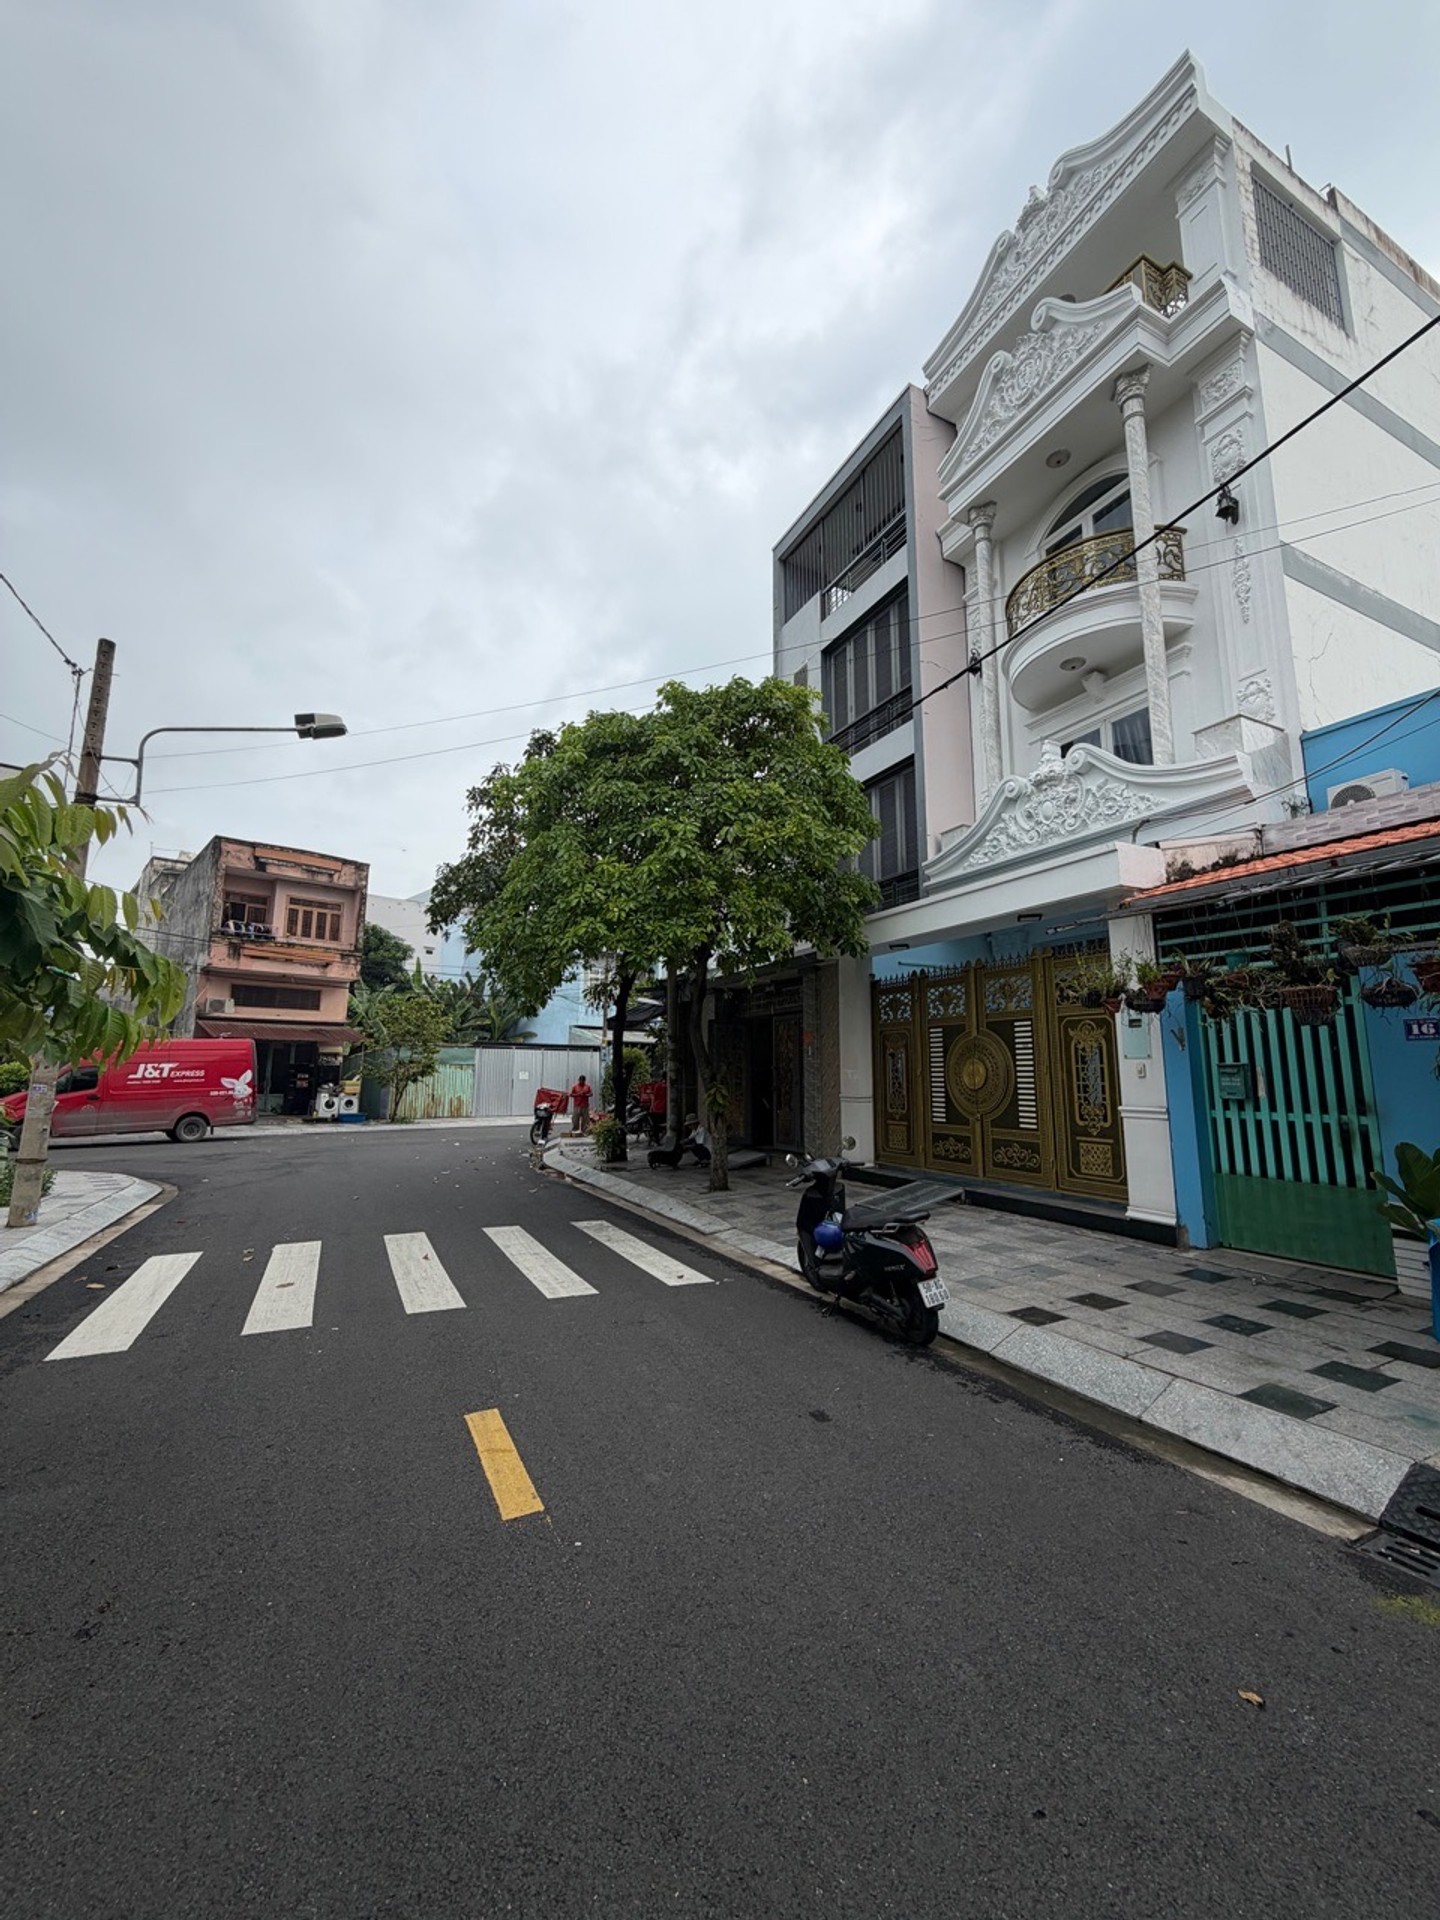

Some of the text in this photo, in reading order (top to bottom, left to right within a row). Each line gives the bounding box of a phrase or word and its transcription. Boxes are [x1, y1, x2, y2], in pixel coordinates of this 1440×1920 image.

[1412, 1023, 1436, 1035] 16
[127, 1062, 205, 1079] J&T EXPRESS
